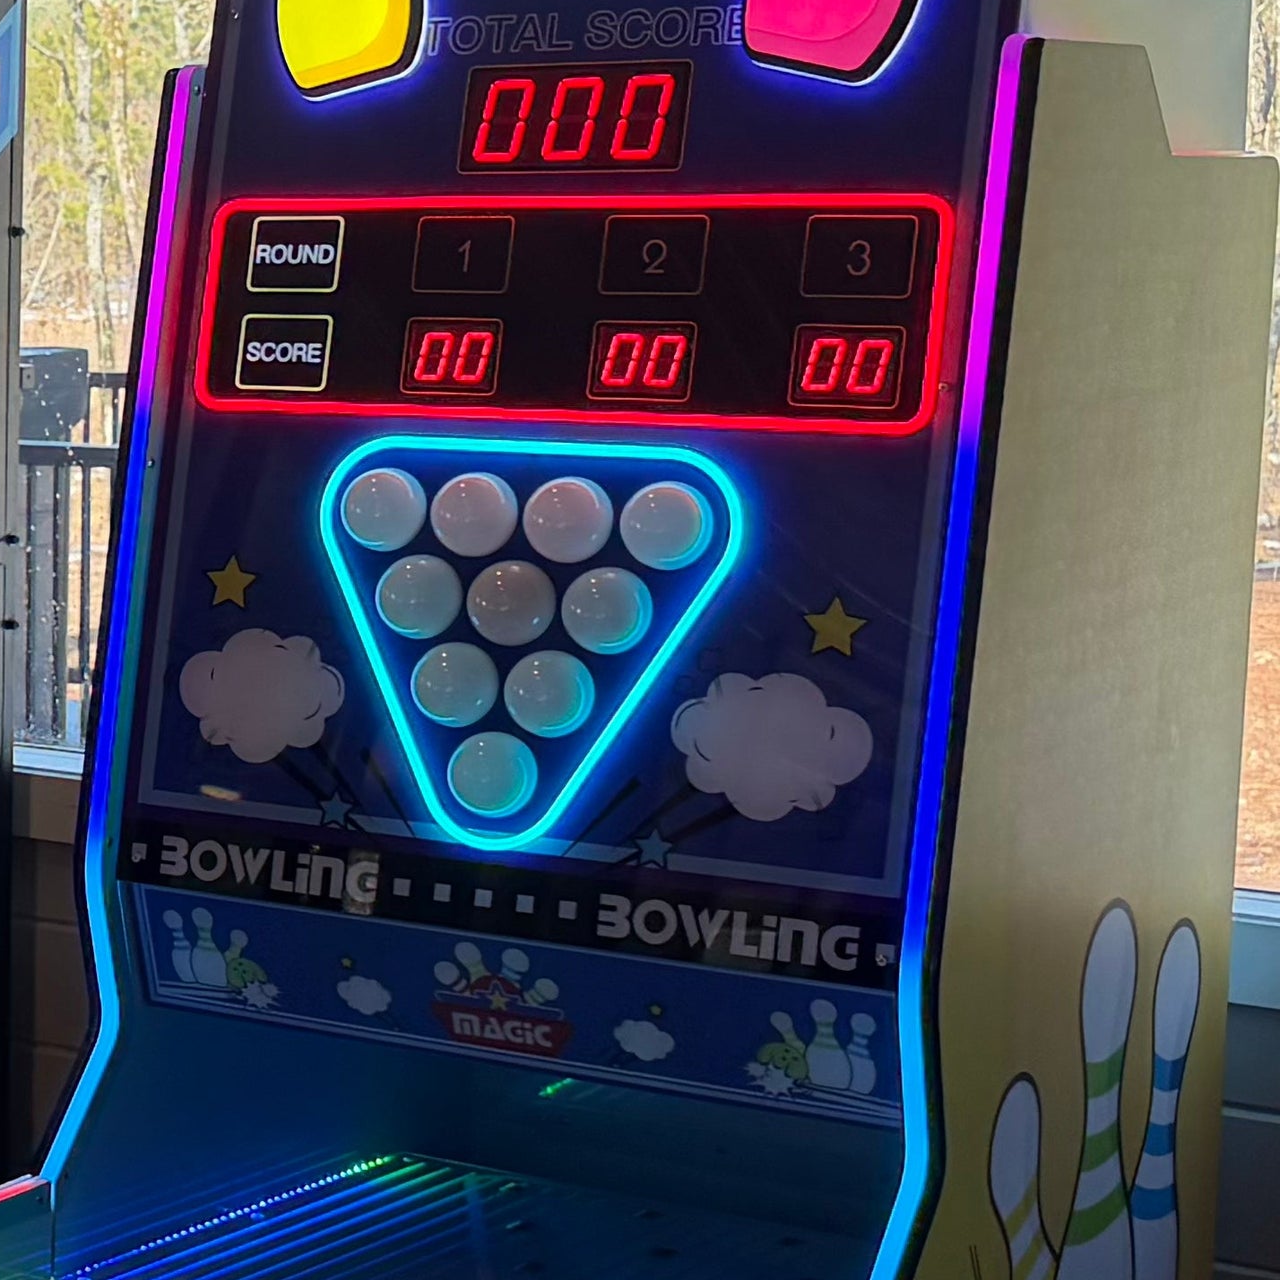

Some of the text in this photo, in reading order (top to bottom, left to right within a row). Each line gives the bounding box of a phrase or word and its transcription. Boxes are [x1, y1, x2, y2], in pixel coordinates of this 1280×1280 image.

[427, 13, 573, 56] TOTAL
[471, 72, 675, 163] 000
[255, 238, 873, 276] ROUND 1 2 3
[246, 331, 893, 392] SCORE 00 00 00
